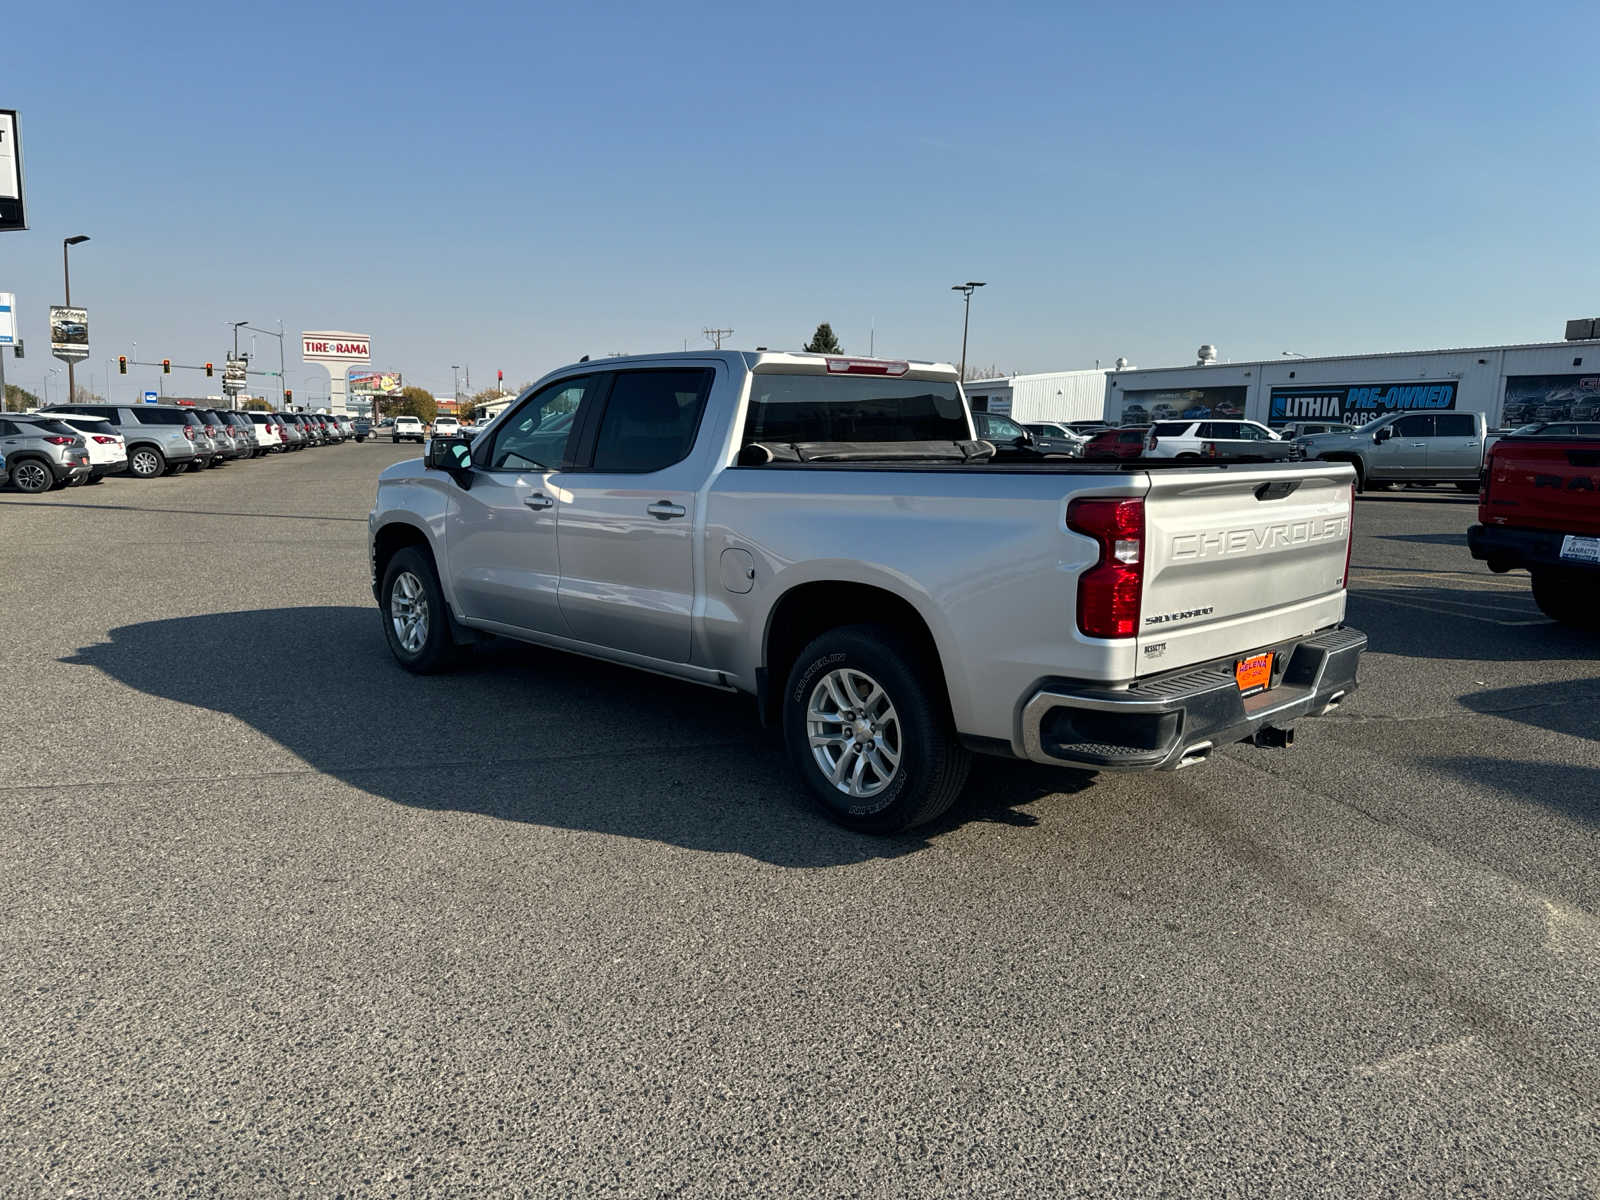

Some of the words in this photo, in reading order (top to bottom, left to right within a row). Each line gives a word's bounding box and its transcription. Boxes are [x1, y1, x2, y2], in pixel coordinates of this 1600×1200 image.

[304, 341, 330, 353] TIRE
[336, 343, 368, 355] RAMA
[1344, 385, 1454, 409] PRE-OWNED
[1285, 397, 1340, 418] LITHIA
[1171, 514, 1348, 561] CHEVROLET
[1144, 606, 1214, 625] SILVERADO
[1239, 660, 1267, 672] HELENA
